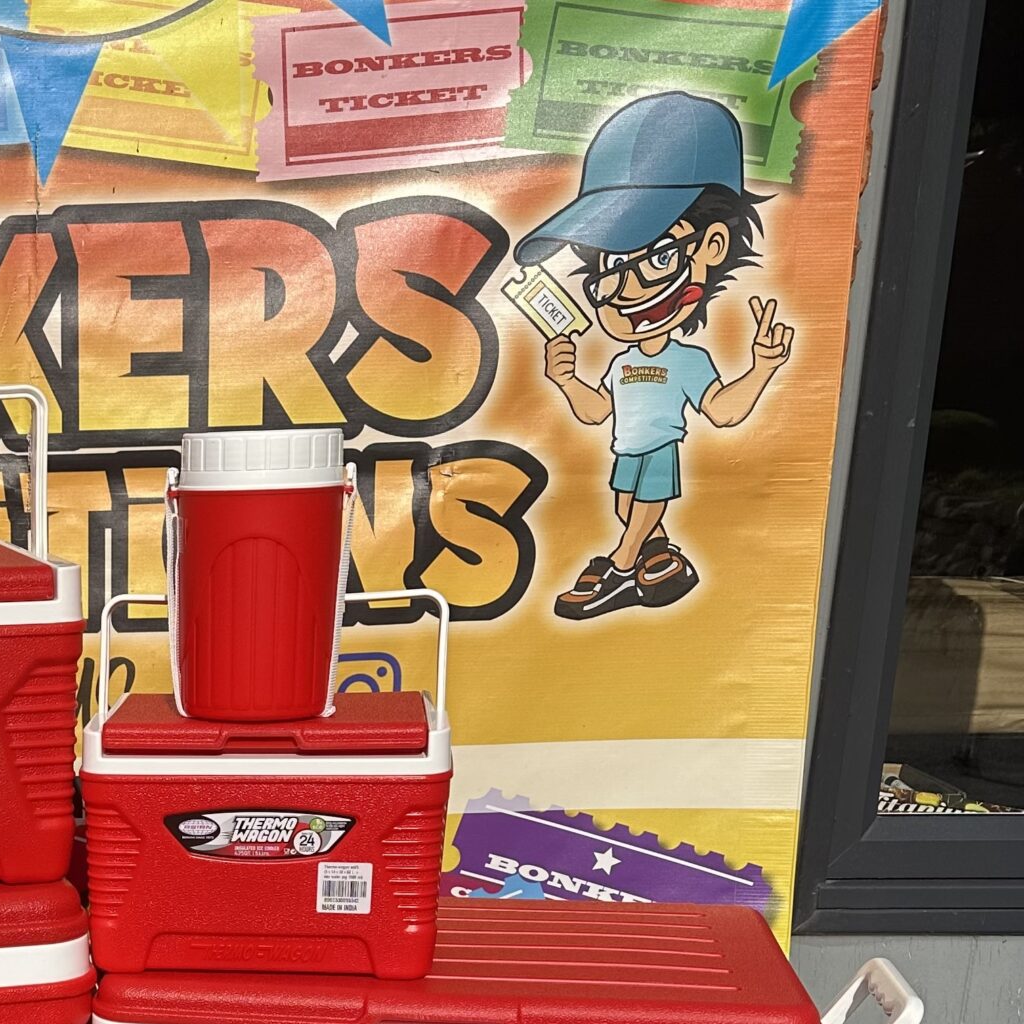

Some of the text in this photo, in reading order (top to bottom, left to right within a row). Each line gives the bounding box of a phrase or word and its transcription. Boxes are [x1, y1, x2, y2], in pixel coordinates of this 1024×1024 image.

[292, 44, 512, 79] BONKERS
[557, 39, 776, 76] BONKERS
[318, 84, 488, 113] TICKET
[538, 293, 567, 325] TICKET
[622, 365, 668, 378] BONKERS
[235, 817, 298, 830] THERMO
[231, 829, 294, 842] WAGON
[299, 834, 315, 846] 24
